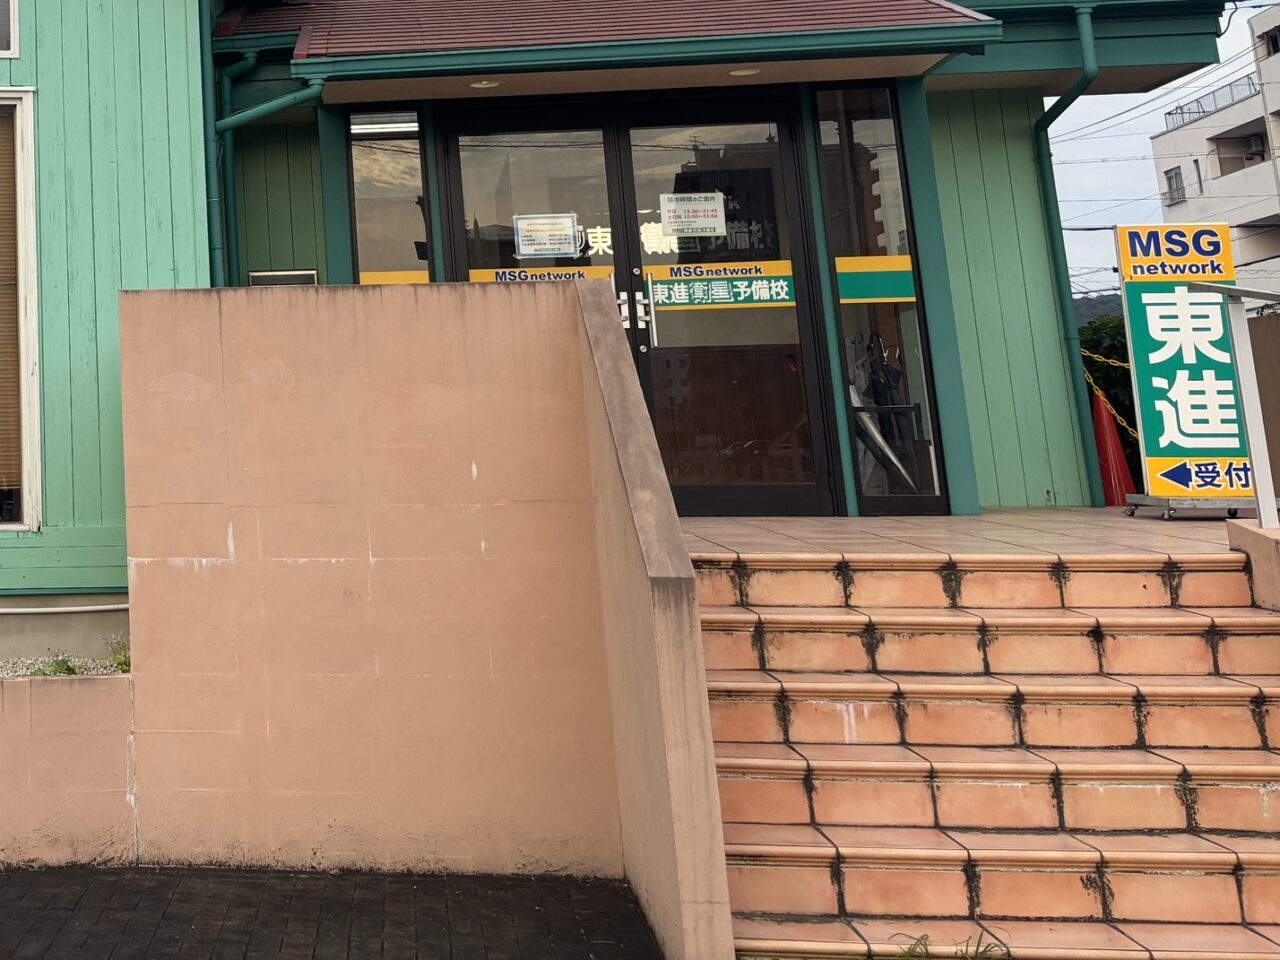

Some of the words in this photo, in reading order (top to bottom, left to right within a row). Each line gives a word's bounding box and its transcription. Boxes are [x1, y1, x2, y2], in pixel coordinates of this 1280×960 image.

[1128, 228, 1222, 258] MSG
[1132, 260, 1224, 276] network
[653, 279, 789, 304] 東進衛星予備校
[1194, 461, 1251, 490] 受付
